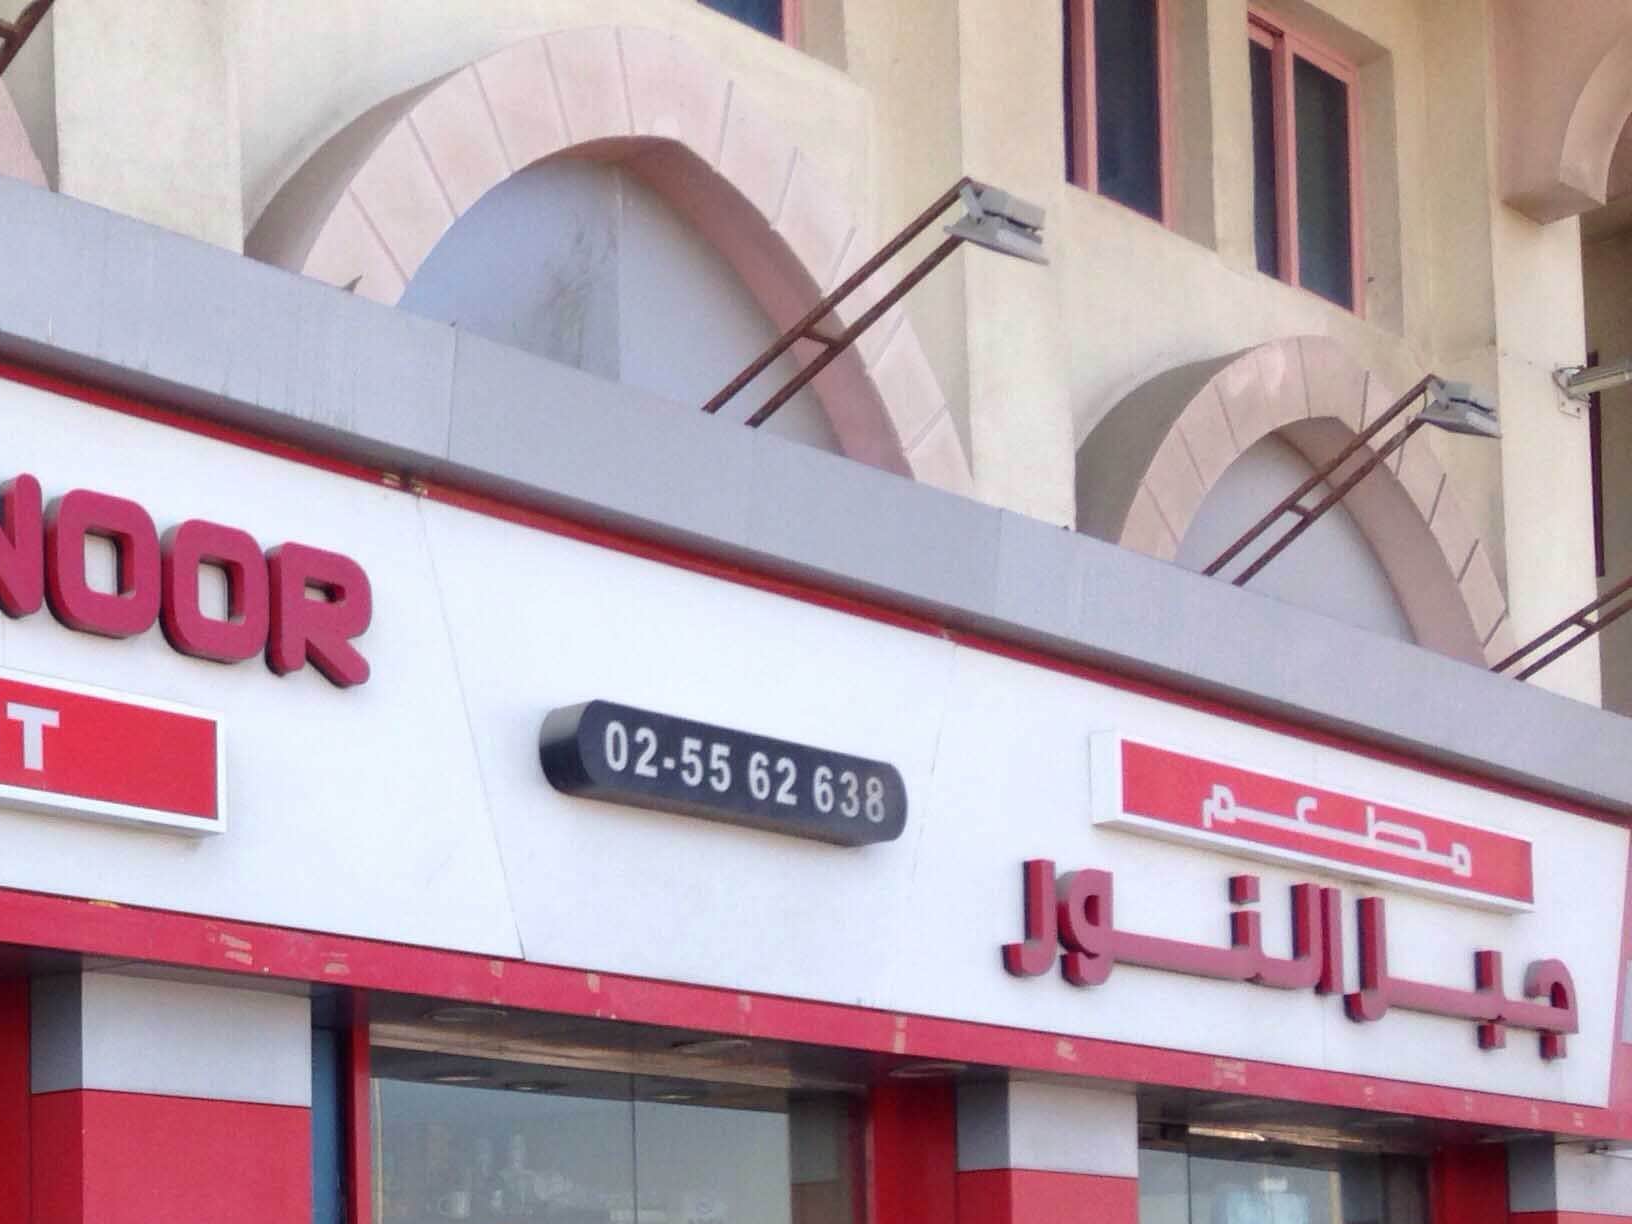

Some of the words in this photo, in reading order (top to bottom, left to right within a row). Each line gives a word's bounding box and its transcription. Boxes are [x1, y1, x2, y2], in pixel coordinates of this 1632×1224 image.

[605, 720, 732, 793] 02-55
[748, 751, 798, 806] 62
[813, 765, 886, 823] 638
[1202, 783, 1472, 878] مطعم
[1002, 858, 1343, 996] النور
[1343, 896, 1580, 1060] جبل
